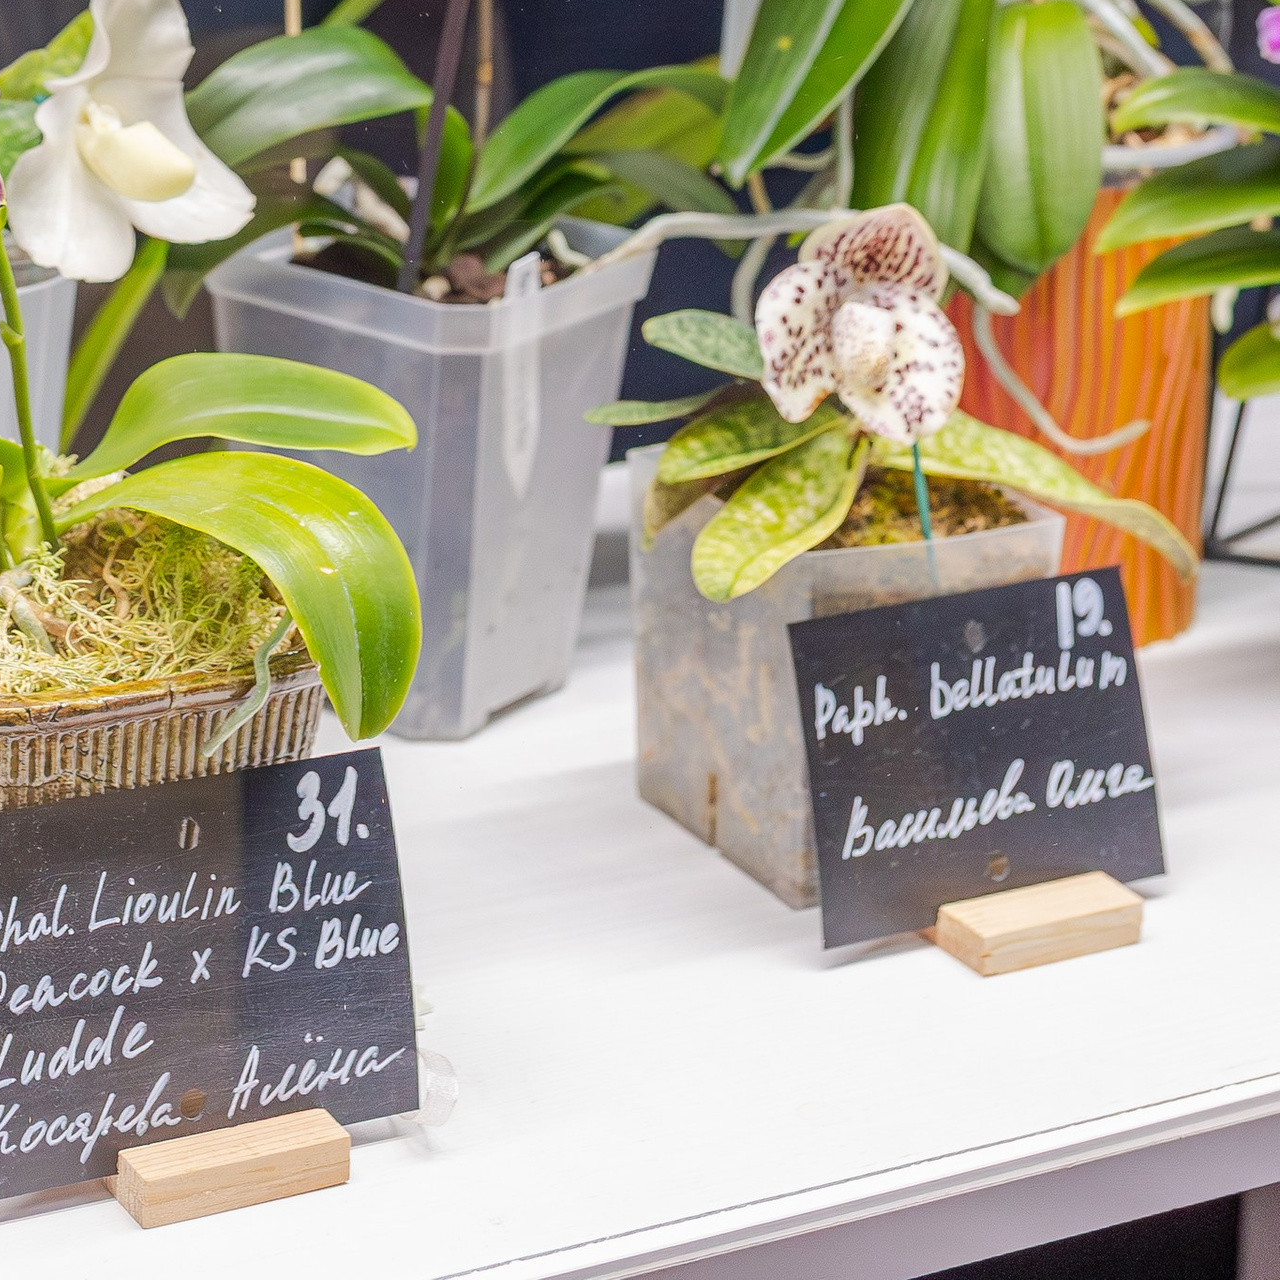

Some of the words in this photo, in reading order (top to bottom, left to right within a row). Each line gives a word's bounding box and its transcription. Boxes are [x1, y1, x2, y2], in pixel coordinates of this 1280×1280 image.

[1055, 577, 1113, 650] 19.
[815, 674, 908, 746] Paph.
[930, 649, 1128, 720] bellatulum
[287, 766, 371, 853] 31.
[89, 871, 242, 932] Lioulin
[269, 859, 373, 915] Blue
[241, 926, 297, 978] KS
[315, 913, 401, 969] Blue
[227, 1032, 405, 1119] Алёна
